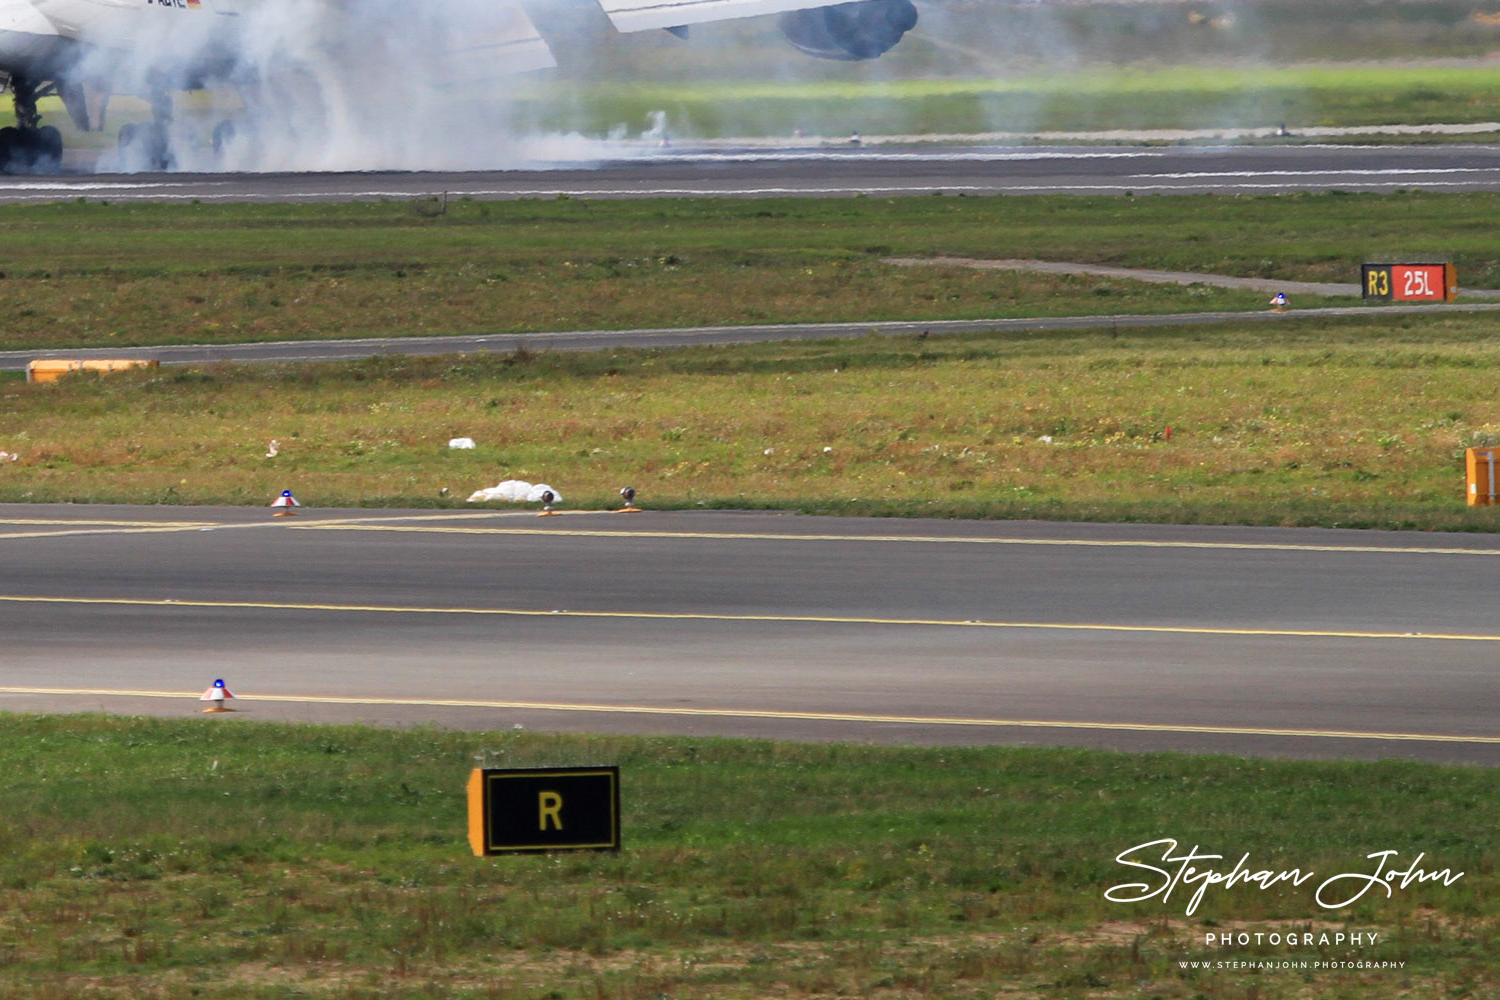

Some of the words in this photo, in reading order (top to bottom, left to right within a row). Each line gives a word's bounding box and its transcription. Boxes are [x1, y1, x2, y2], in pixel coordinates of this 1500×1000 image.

[1368, 270, 1389, 295] R3
[1404, 271, 1434, 296] 25L
[538, 791, 563, 831] R
